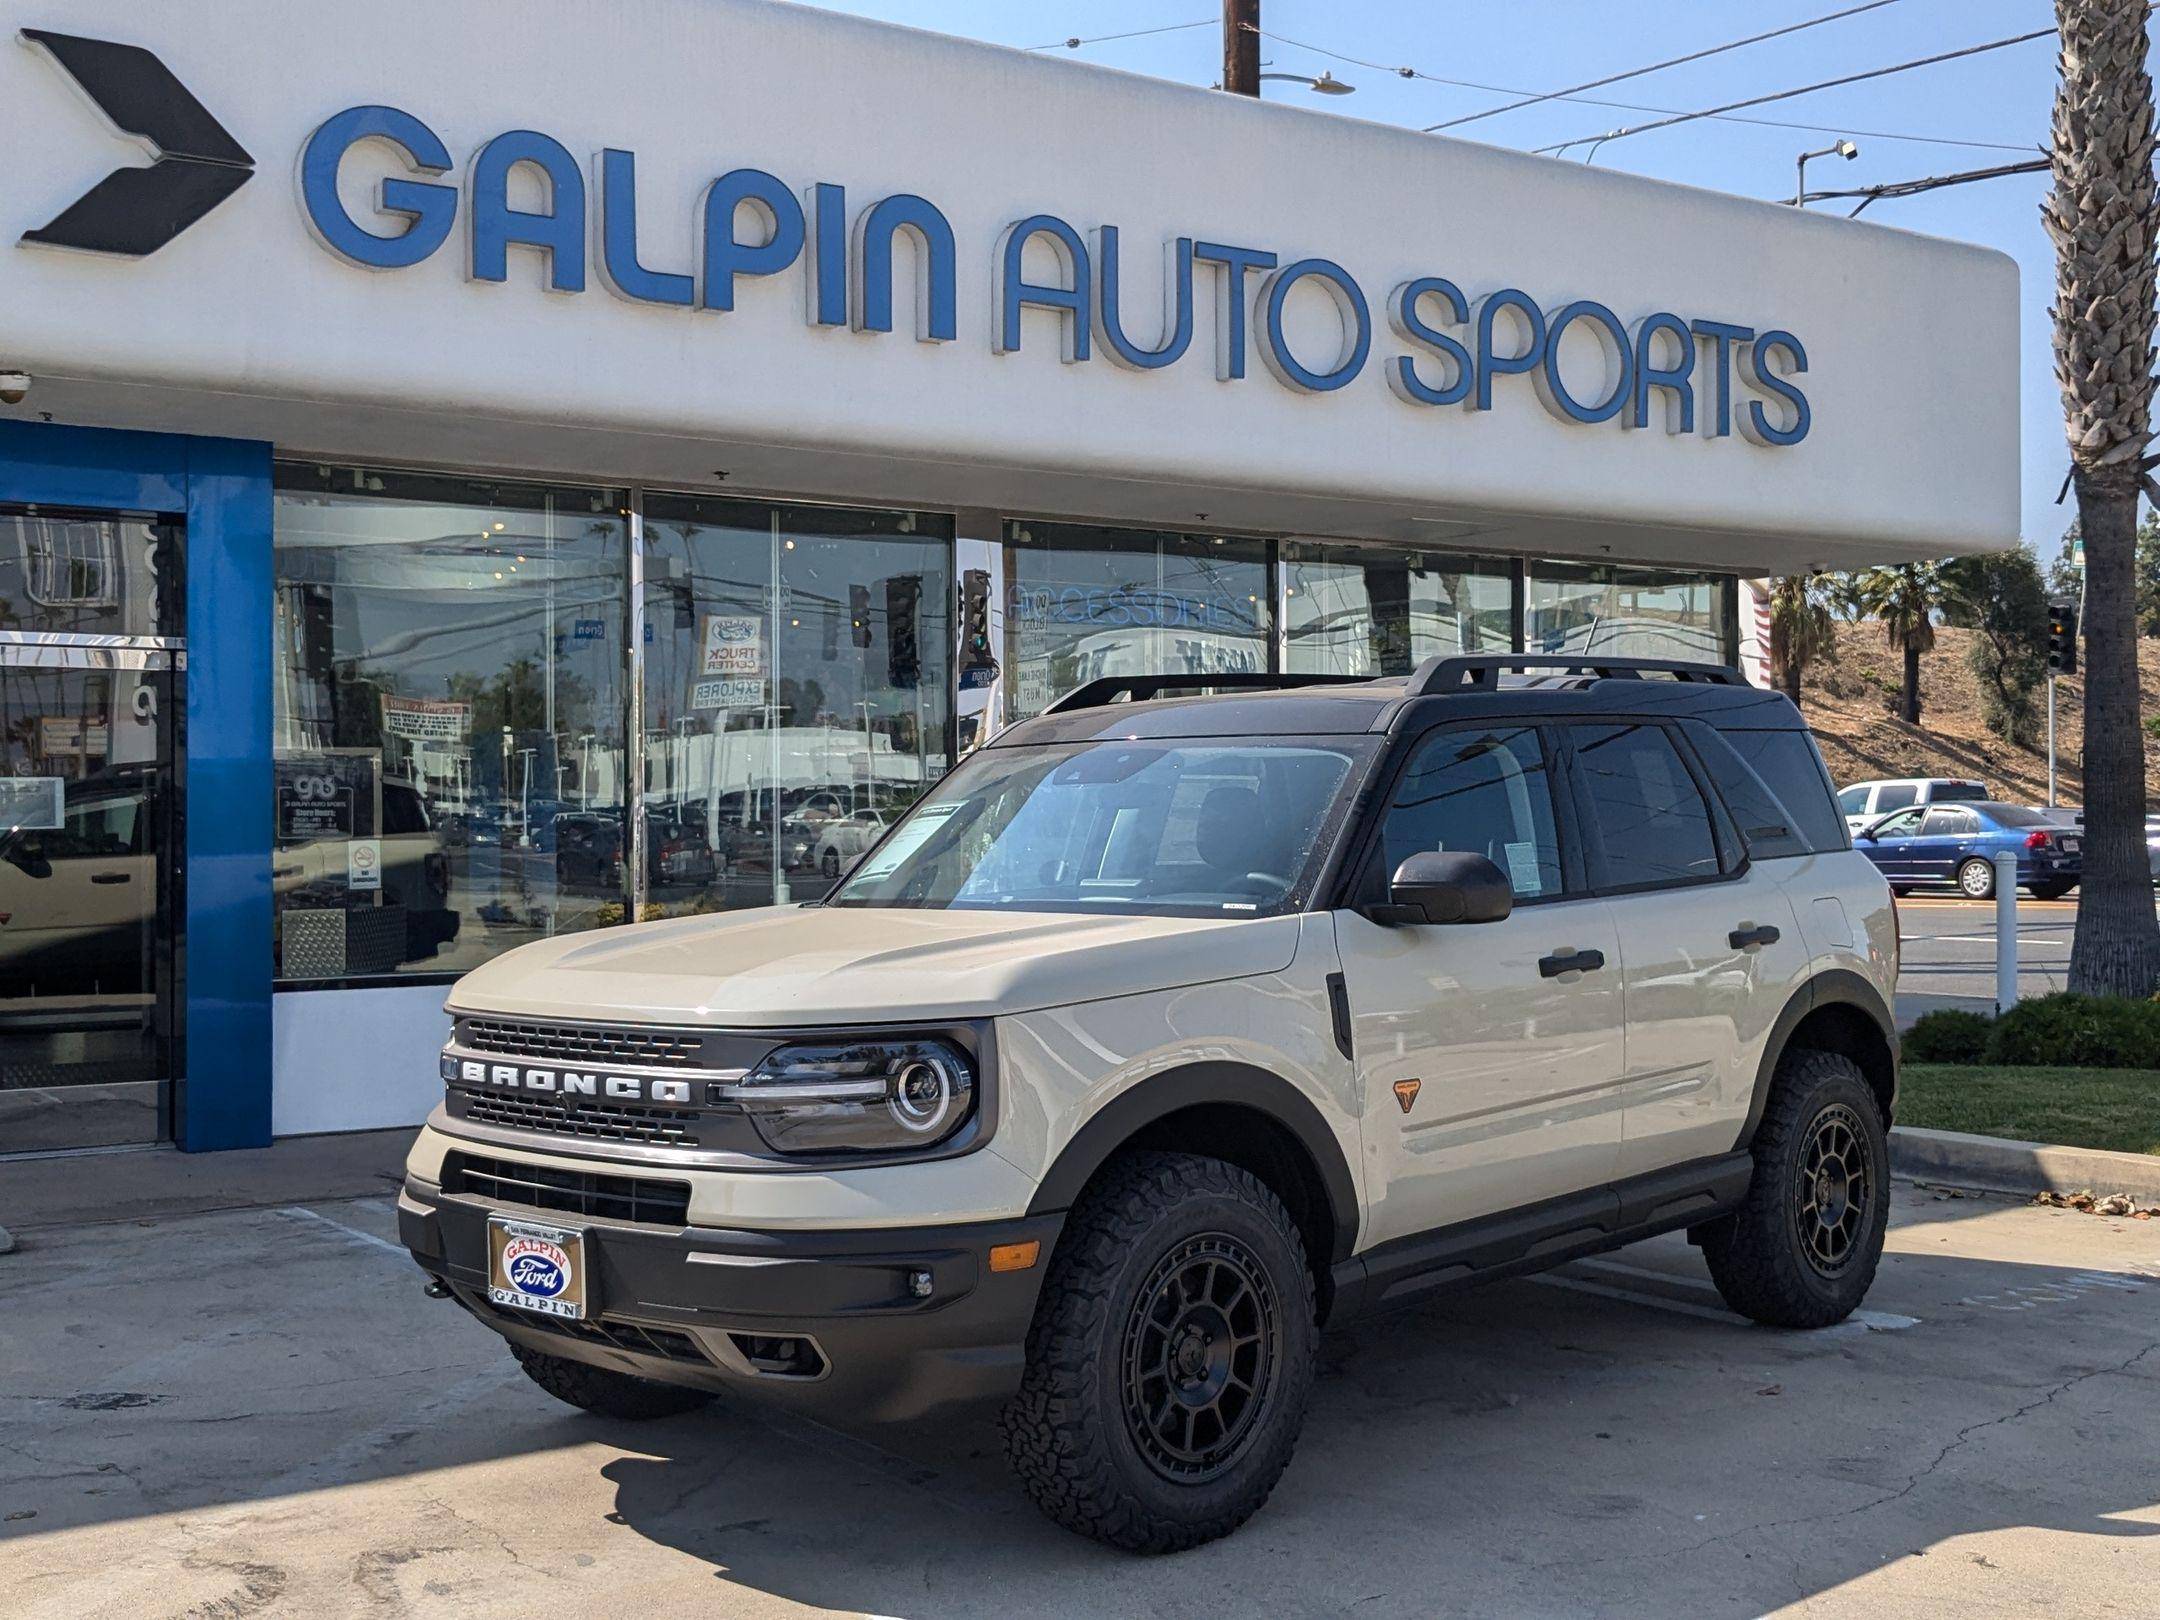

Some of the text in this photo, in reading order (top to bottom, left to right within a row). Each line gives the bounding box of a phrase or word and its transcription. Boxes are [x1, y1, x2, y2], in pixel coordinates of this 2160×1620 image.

[299, 104, 1811, 447] GALPIN AUTO SPORTS
[1008, 585, 1255, 630] ACCESSORIES
[462, 1061, 691, 1103] BRONCO
[507, 1239, 565, 1268] GALPIN
[514, 1258, 558, 1289] Ford
